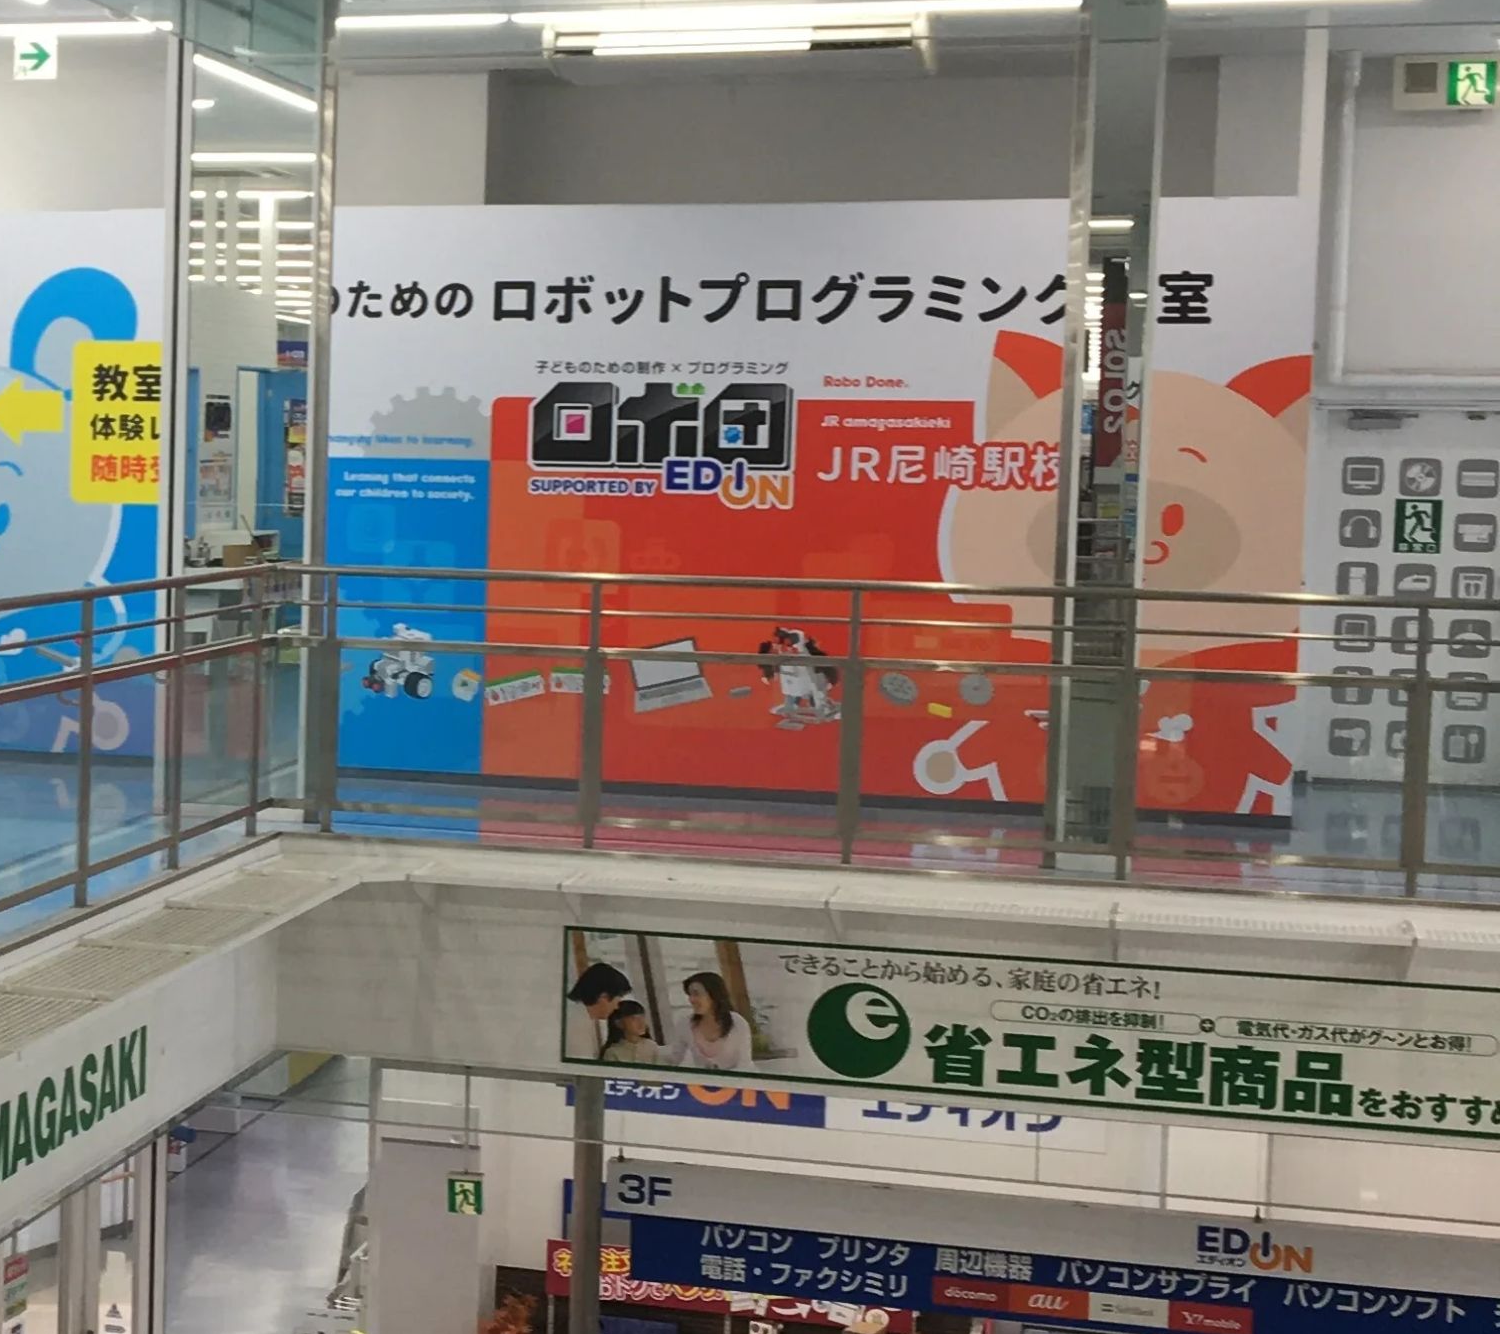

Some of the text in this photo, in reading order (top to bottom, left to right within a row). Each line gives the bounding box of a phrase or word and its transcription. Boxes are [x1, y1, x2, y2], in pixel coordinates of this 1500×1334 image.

[688, 360, 790, 375] プログラミング
[823, 375, 909, 388] Robo Done.
[393, 472, 419, 483] that
[530, 460, 790, 507] SUPPORTED BY EDION
[778, 953, 1161, 1001] できることから始める、家庭の省エネ!
[617, 1174, 673, 1207] 3F
[1197, 1224, 1314, 1274] EDION
[700, 1223, 794, 1255] パソコン
[818, 1236, 911, 1268] プリンタ
[934, 1247, 1034, 1283] 周辺機器
[1056, 1260, 1258, 1304] パソコンサプライ
[1283, 1283, 1467, 1324] パソコンソフト
[700, 1255, 910, 1300] 電話・ファクシミリ
[1027, 1293, 1071, 1311] au
